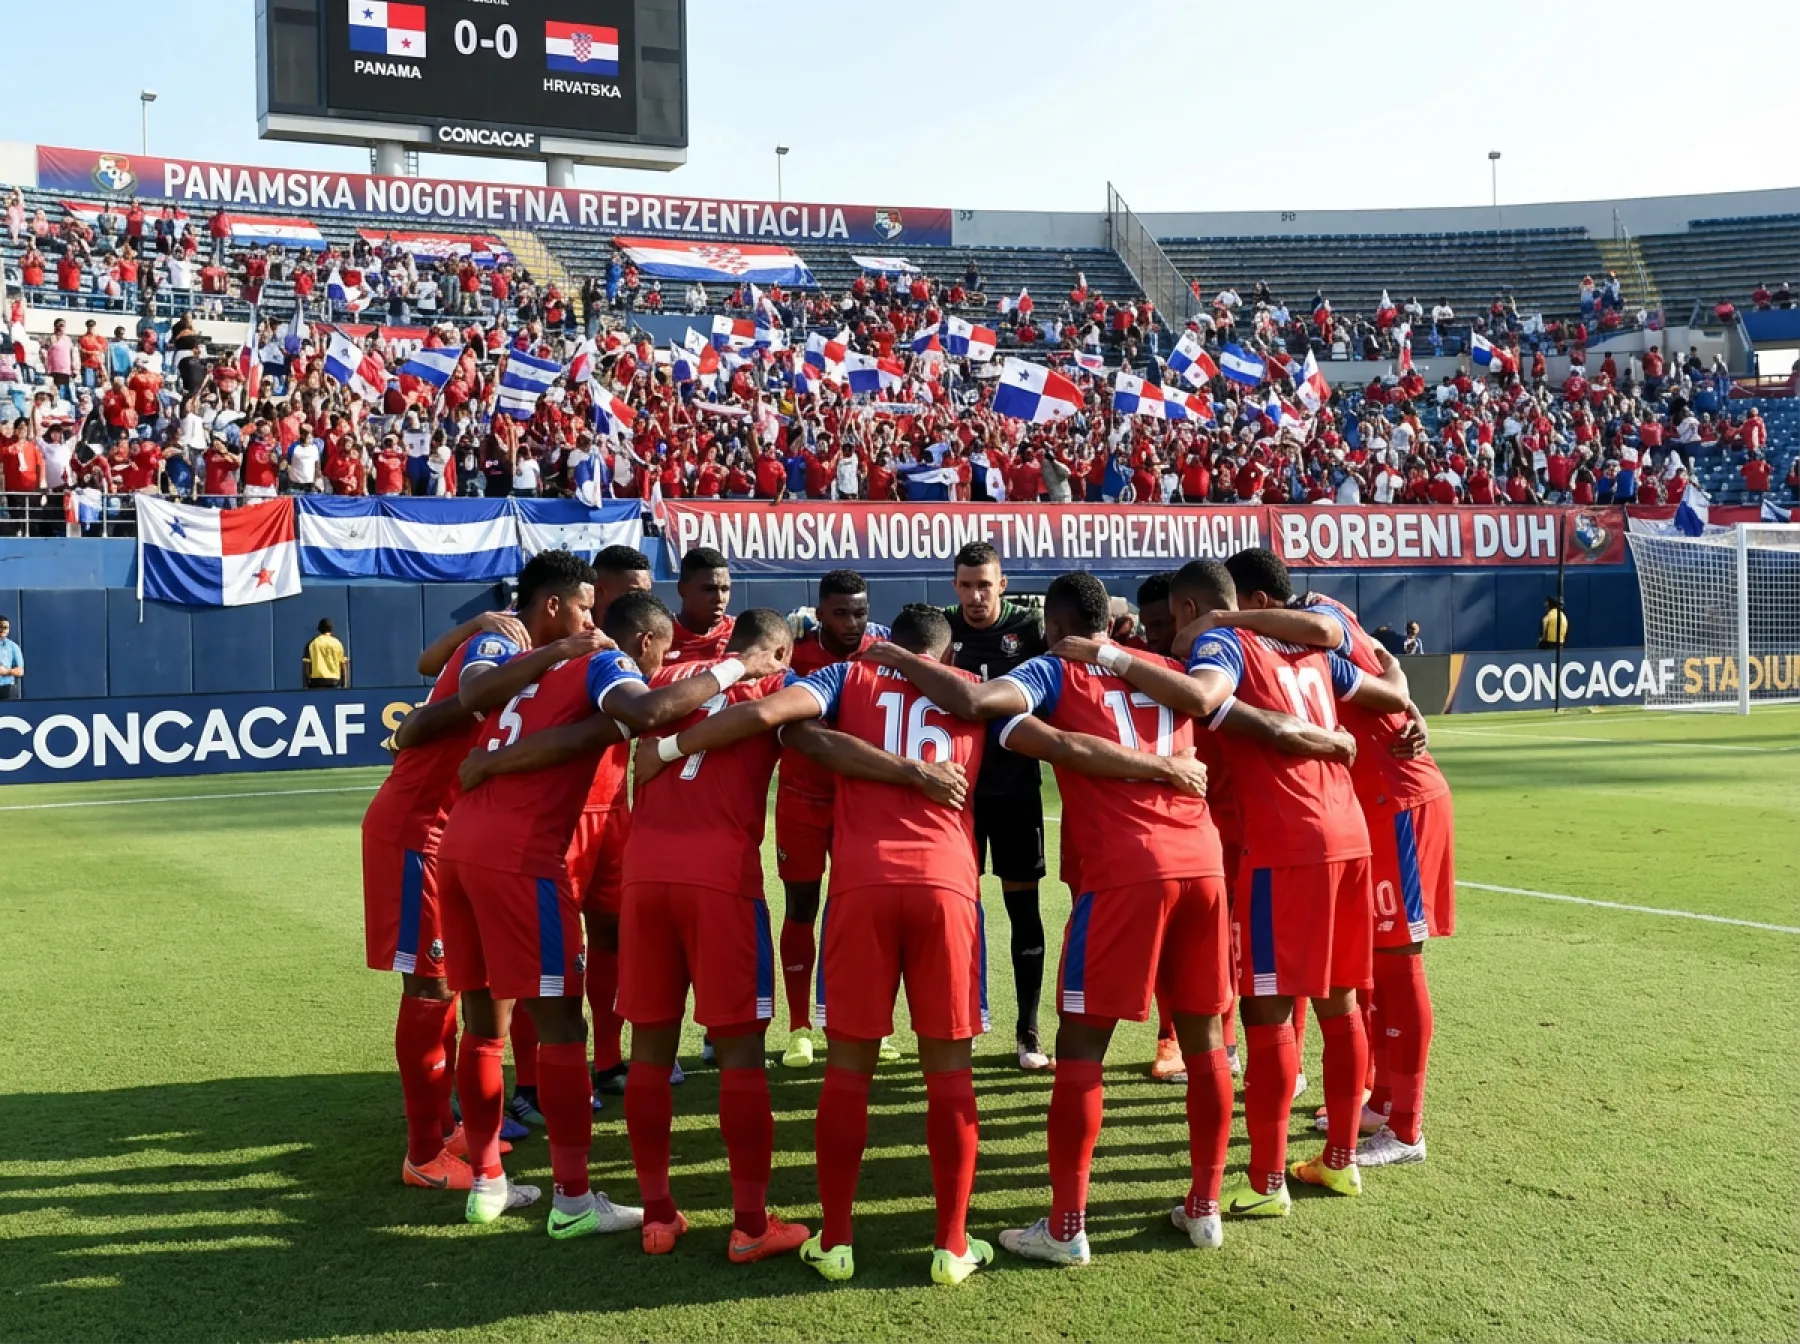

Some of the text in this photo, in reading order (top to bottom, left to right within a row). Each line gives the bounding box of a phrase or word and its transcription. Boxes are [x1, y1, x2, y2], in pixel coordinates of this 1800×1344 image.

[454, 19, 518, 59] 0-0
[354, 60, 422, 79] PANAMA
[543, 78, 621, 98] HRVATSKA
[438, 126, 535, 148] CONCACAF
[163, 163, 849, 238] PANAMSKA NOGOMETNA REPREZENTACIJA
[677, 512, 1261, 559] PANAMSKA NOGOMETNA REPREZENTACIJA
[1281, 514, 1556, 559] BORBENI DUH
[1475, 655, 1800, 703] CONCACAF STADIU
[0, 703, 366, 771] CONCACAF
[876, 691, 953, 763] 16
